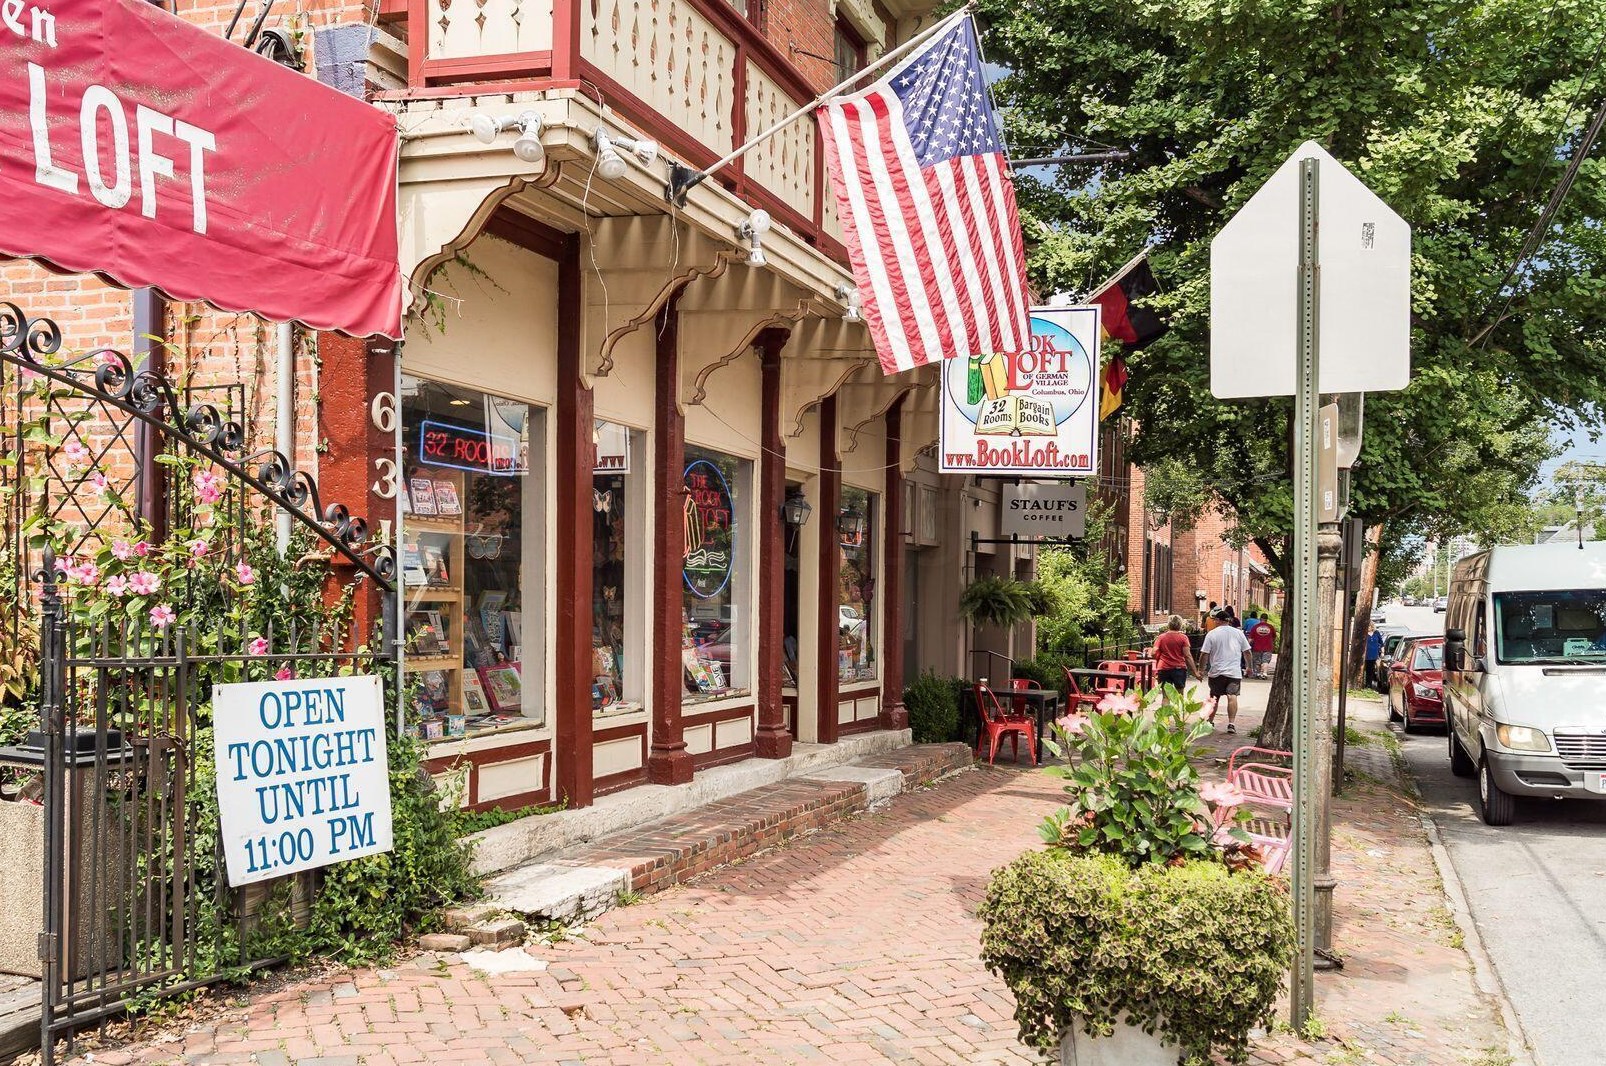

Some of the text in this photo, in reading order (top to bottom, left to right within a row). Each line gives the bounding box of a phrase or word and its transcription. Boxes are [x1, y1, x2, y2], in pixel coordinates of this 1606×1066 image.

[28, 61, 217, 235] LOFT
[1004, 350, 1073, 391] LOFT
[1031, 388, 1067, 396] Columbus,
[983, 413, 1012, 425] Rooms
[989, 400, 1007, 415] 32
[1019, 399, 1050, 416] Bargain
[1019, 412, 1050, 427] Books
[425, 431, 447, 456] 32
[945, 439, 1089, 468] www.BookLoft.com
[1010, 500, 1078, 511] STAUF'S
[1023, 514, 1064, 522] COFFEE
[259, 687, 346, 730] OPEN
[228, 728, 376, 781] TONIGHT
[256, 773, 360, 825] UNTIL
[244, 812, 377, 873] 11:00 PM
